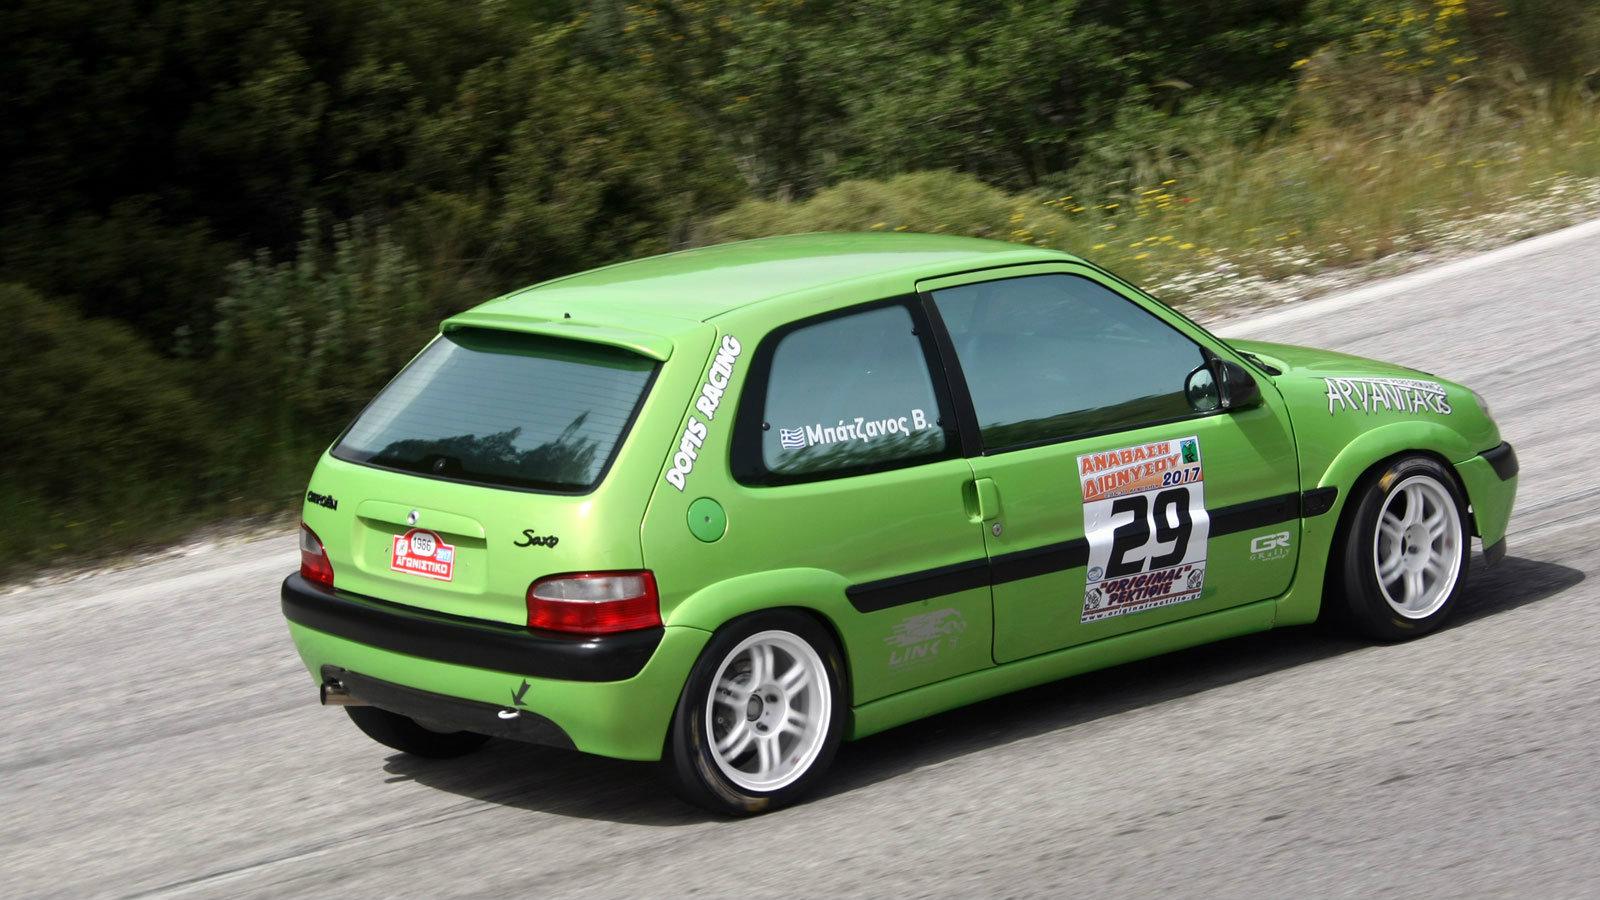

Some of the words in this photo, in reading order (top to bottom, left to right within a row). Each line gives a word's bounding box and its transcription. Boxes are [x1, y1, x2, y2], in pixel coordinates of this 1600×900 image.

[665, 416, 707, 492] DOFIS
[695, 334, 741, 421] RACING
[805, 416, 910, 447] Μπάτζανος
[911, 408, 932, 430] Β.
[1082, 441, 1171, 476] ΑΝΑΒΑΣΗ
[1085, 453, 1181, 499] ΔΙΟΝΥΣΟΥ
[1162, 466, 1200, 487] 2017
[413, 536, 433, 552] 1986
[513, 528, 559, 549] Saxo
[1104, 487, 1193, 579] 29
